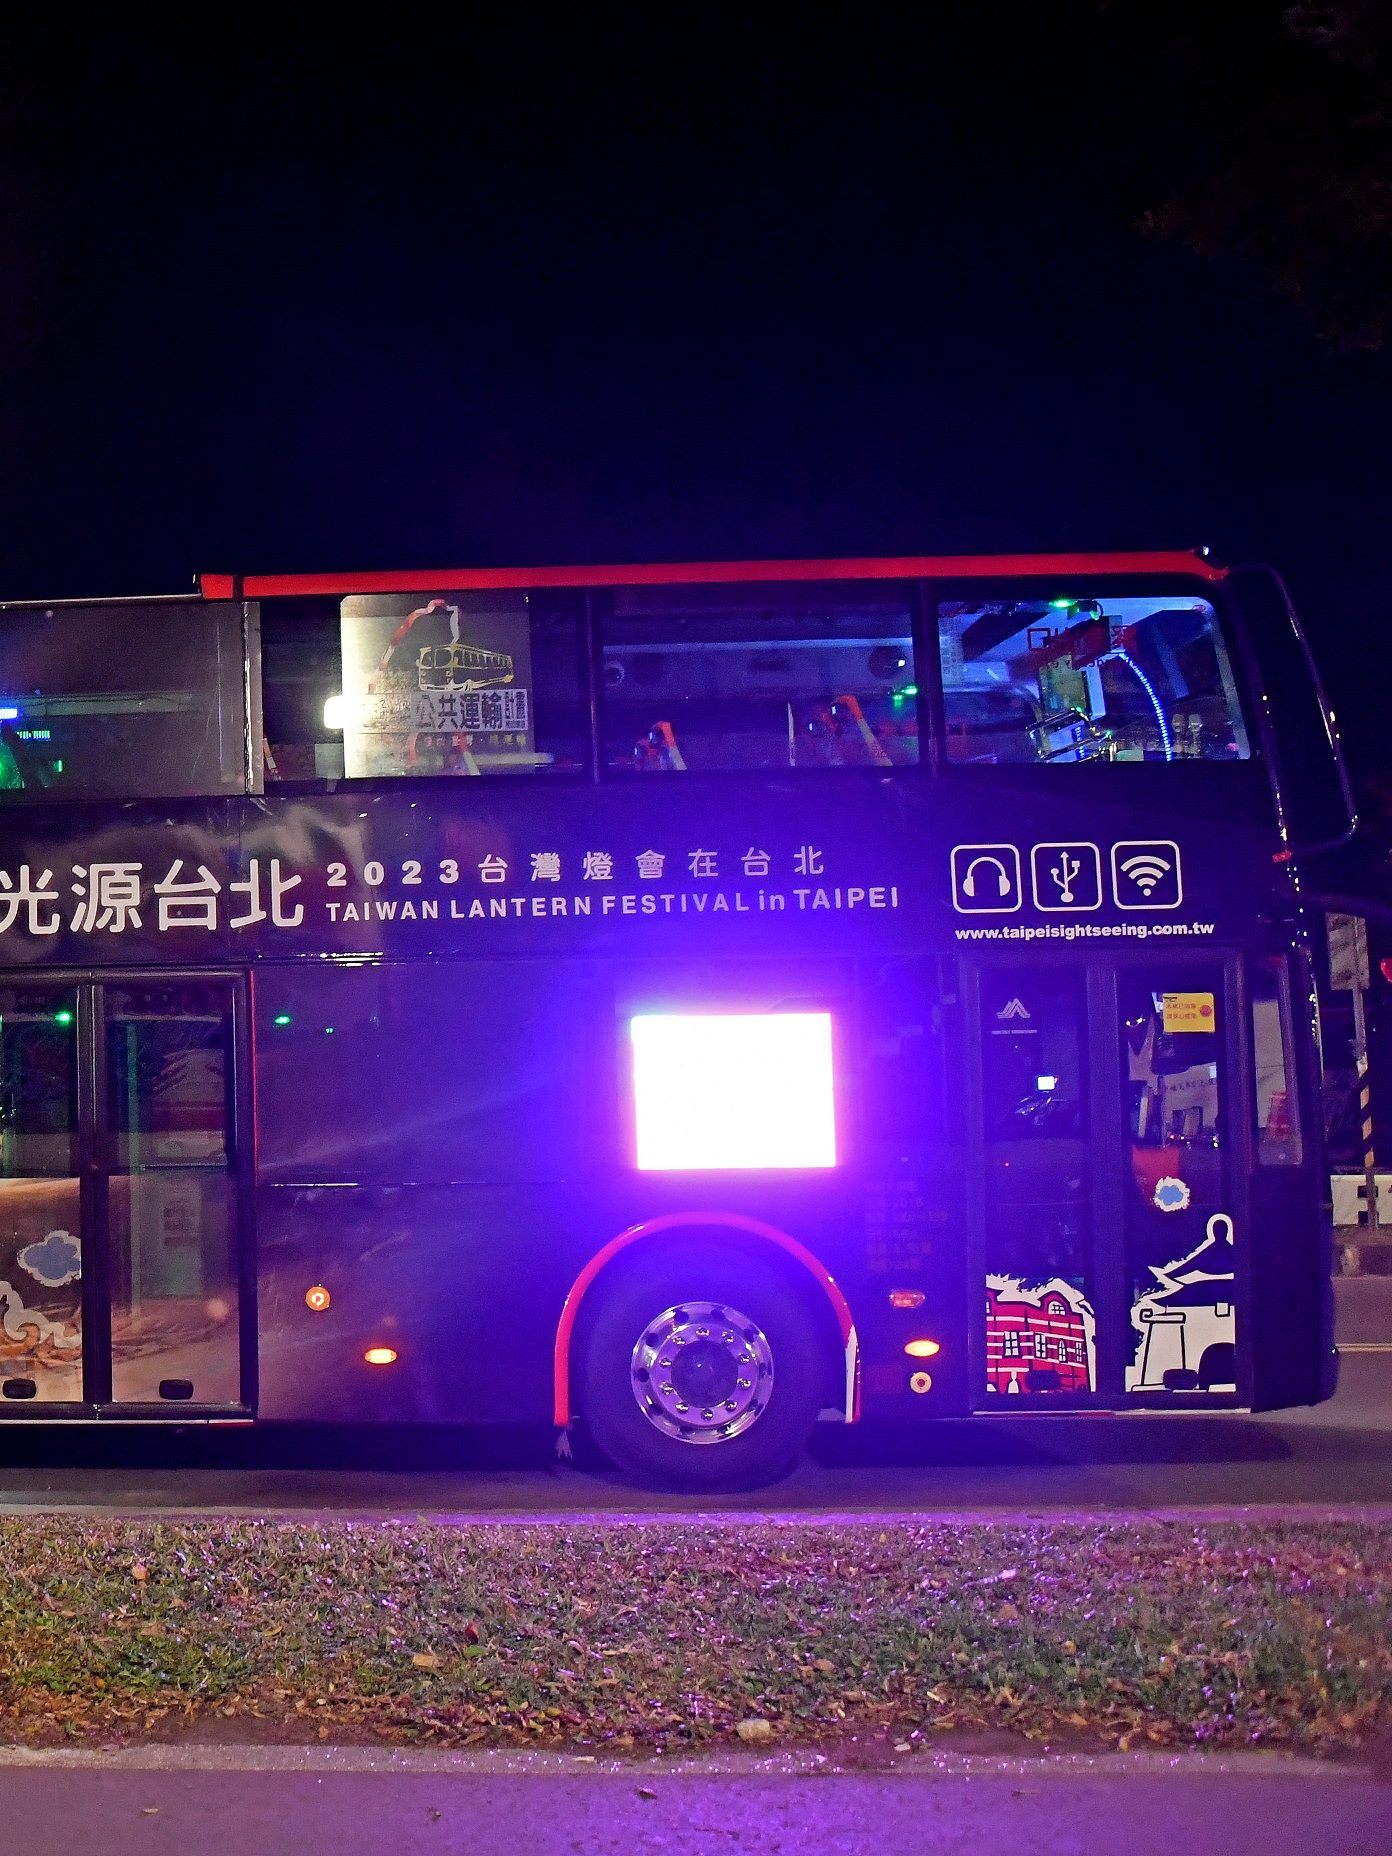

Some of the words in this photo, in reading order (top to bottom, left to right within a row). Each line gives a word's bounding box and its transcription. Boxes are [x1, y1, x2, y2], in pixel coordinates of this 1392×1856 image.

[326, 900, 439, 922] TAIWAN
[451, 896, 592, 919] LANTERN
[602, 892, 750, 915] FESTIVAL
[758, 889, 785, 911] in
[793, 886, 899, 910] TAIPEI
[955, 922, 1215, 940] www.taipeisightseeing.com.tw
